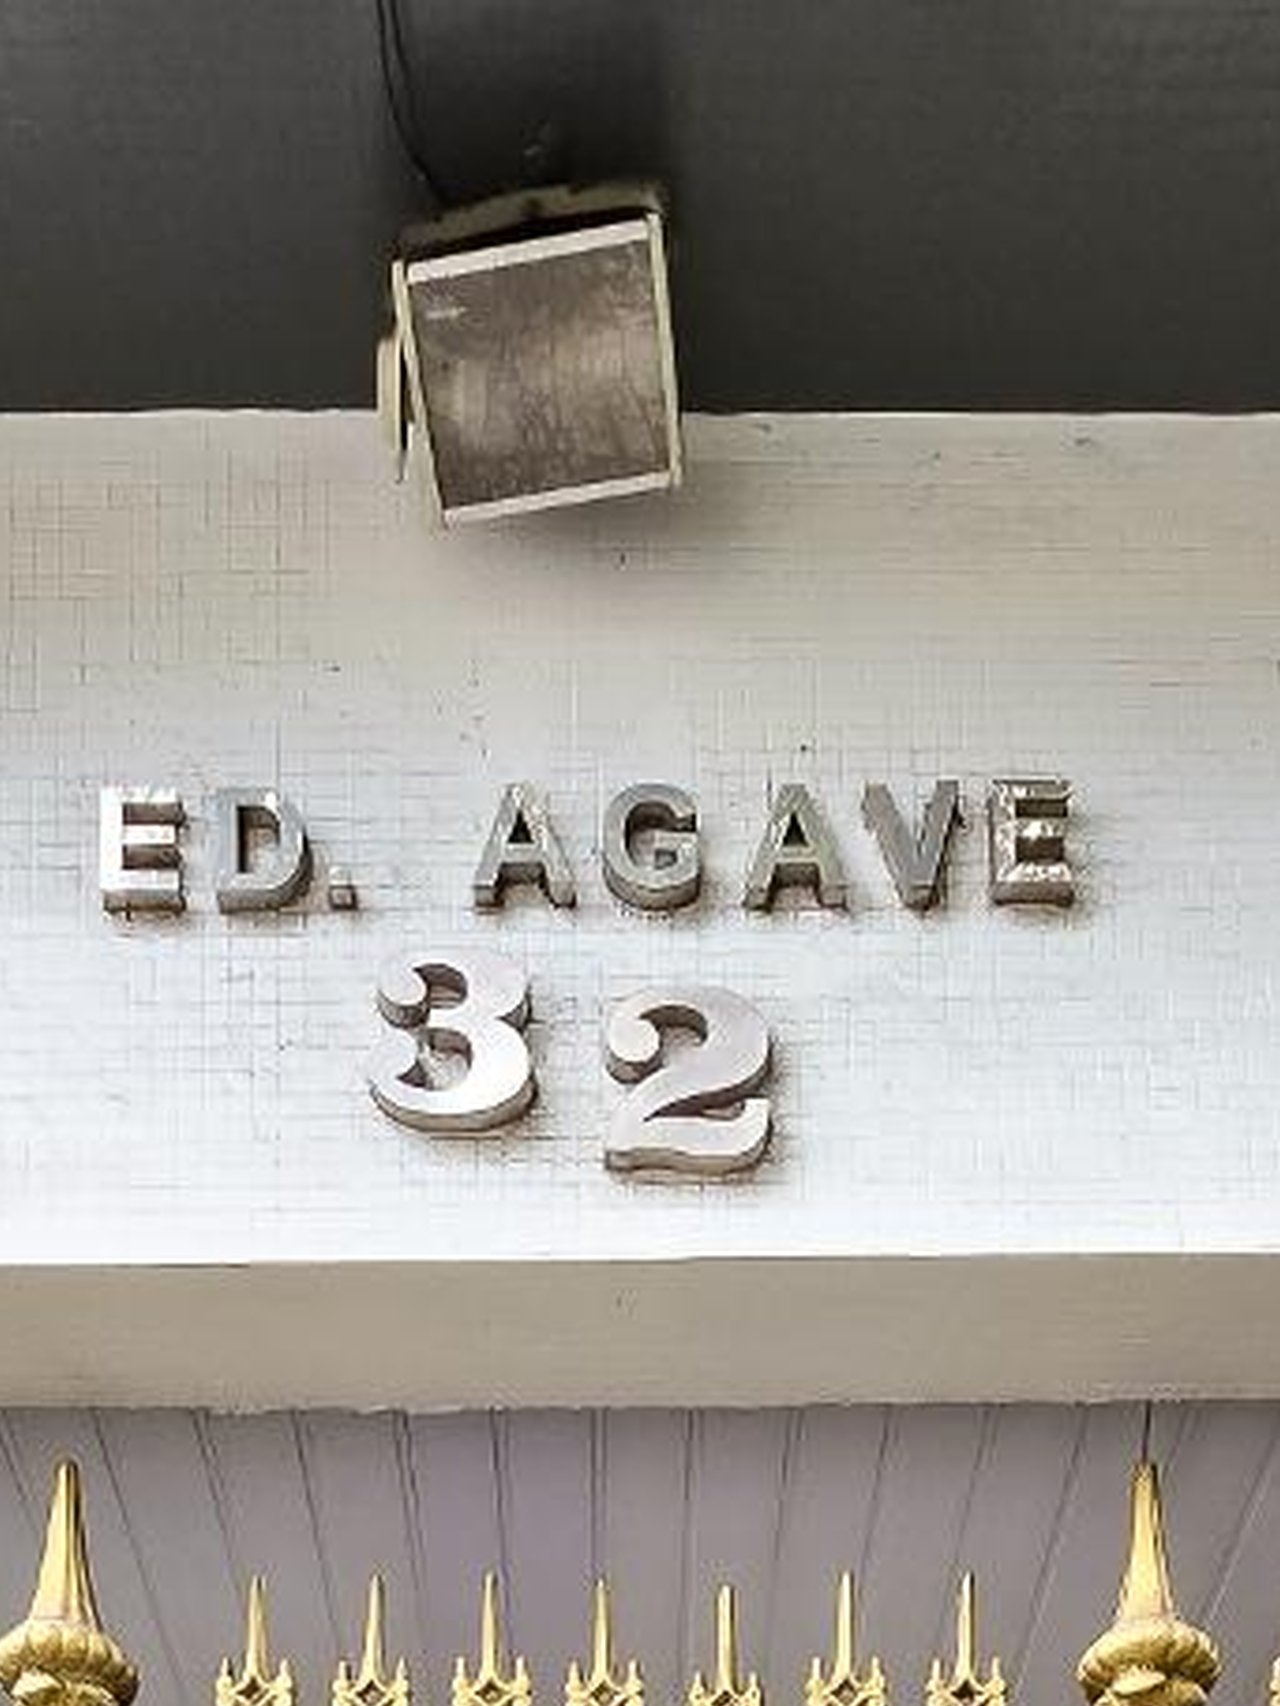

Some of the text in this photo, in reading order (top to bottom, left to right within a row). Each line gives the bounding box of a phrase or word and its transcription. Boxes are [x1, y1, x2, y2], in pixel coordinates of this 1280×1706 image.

[98, 778, 1078, 914] ED. AGAVE
[369, 946, 774, 1182] 32
